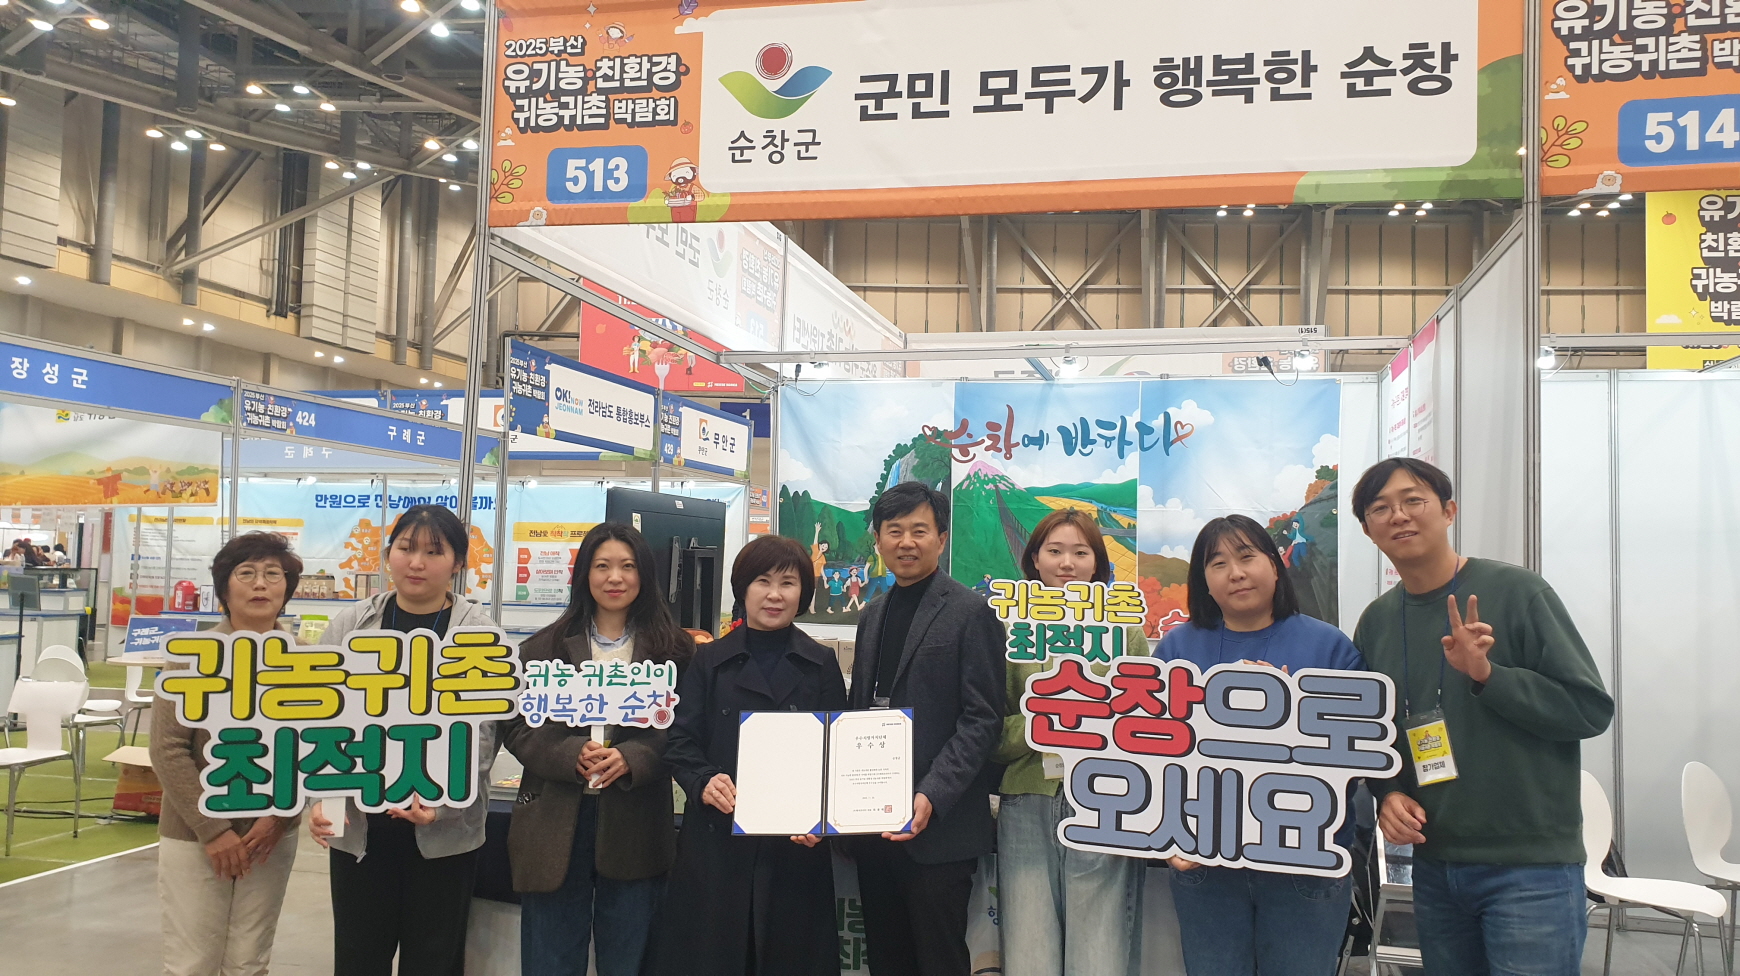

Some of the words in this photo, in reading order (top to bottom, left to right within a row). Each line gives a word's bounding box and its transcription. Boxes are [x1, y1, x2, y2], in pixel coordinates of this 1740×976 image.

[1566, 33, 1702, 76] 귀농귀촌
[853, 70, 951, 122] 군민
[972, 59, 1131, 116] 모두가
[1152, 49, 1319, 109] 행복한
[1339, 41, 1460, 100] 순창
[513, 95, 608, 128] 귀농귀촌
[613, 96, 676, 123] 박람회
[727, 128, 823, 165] 순창군
[1644, 107, 1740, 154] 514
[565, 157, 629, 194] 513
[10, 356, 89, 389] 장성군
[295, 410, 316, 427] 424
[554, 403, 584, 416] JEONNAM
[587, 398, 614, 420] 전라남도
[615, 405, 651, 428] 통합홍보부스
[387, 425, 426, 446] 구례군
[713, 432, 736, 454] 무안군
[1056, 410, 1173, 459] 반하다
[314, 494, 371, 509] 만원으로
[988, 581, 1145, 623] 귀농귀촌
[1008, 623, 1124, 663] 최적지
[161, 631, 515, 722] 귀농귀촌
[525, 661, 575, 689] 귀농
[581, 660, 676, 688] 귀촌인이
[521, 691, 609, 723] 행복한
[617, 690, 678, 724] 순창
[1025, 658, 1395, 770] 순창으로
[204, 720, 474, 812] 최적지
[1063, 757, 1342, 871] 오세요
